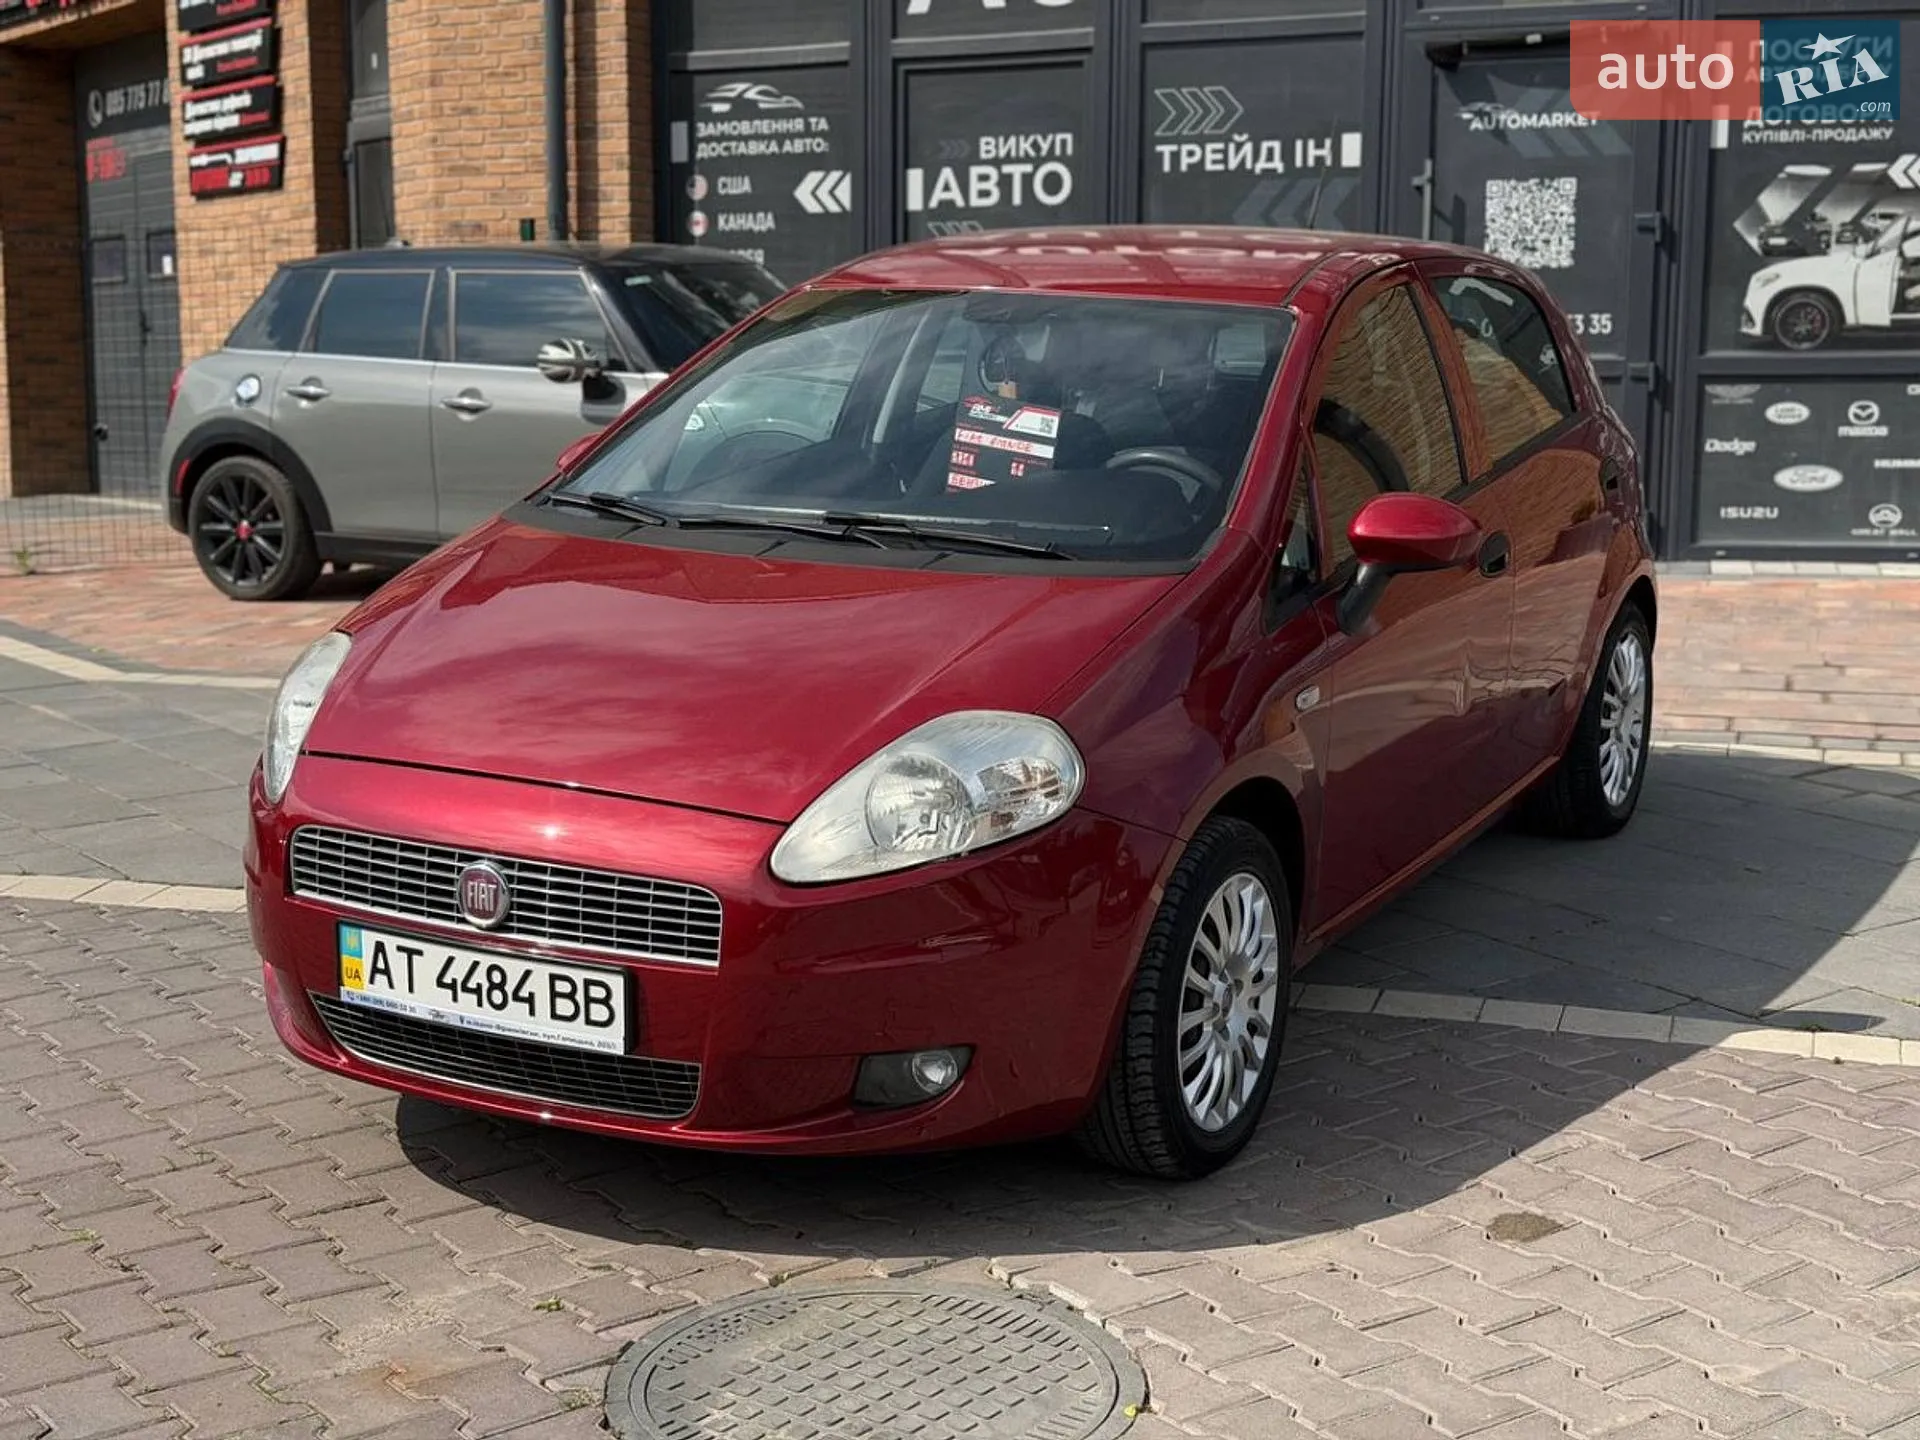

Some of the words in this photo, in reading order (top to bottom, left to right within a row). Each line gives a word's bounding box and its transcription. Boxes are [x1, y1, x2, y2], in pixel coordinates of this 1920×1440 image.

[696, 118, 804, 137] ЗАМОВЛЕННЯ
[808, 117, 829, 132] ТА
[1469, 110, 1601, 131] AUTOMARKET
[979, 132, 1074, 160] ВИКУП
[1741, 127, 1895, 145] КУПІВЛІ-ПРОДАЖУ
[696, 142, 780, 160] ДОСТАВКА
[1155, 133, 1285, 175] ТРЕЙД
[1294, 137, 1333, 168] ІН
[717, 175, 752, 195] США
[928, 161, 1073, 210] АВТО
[717, 211, 776, 233] КАНАДА
[1588, 313, 1613, 335] 35
[1704, 437, 1757, 456] Dodge
[1720, 506, 1779, 519] ISUZU
[468, 880, 498, 912] FIAT
[345, 966, 361, 981] UA
[369, 940, 424, 994] AT
[436, 955, 535, 1017] 4484
[549, 972, 616, 1028] BB
